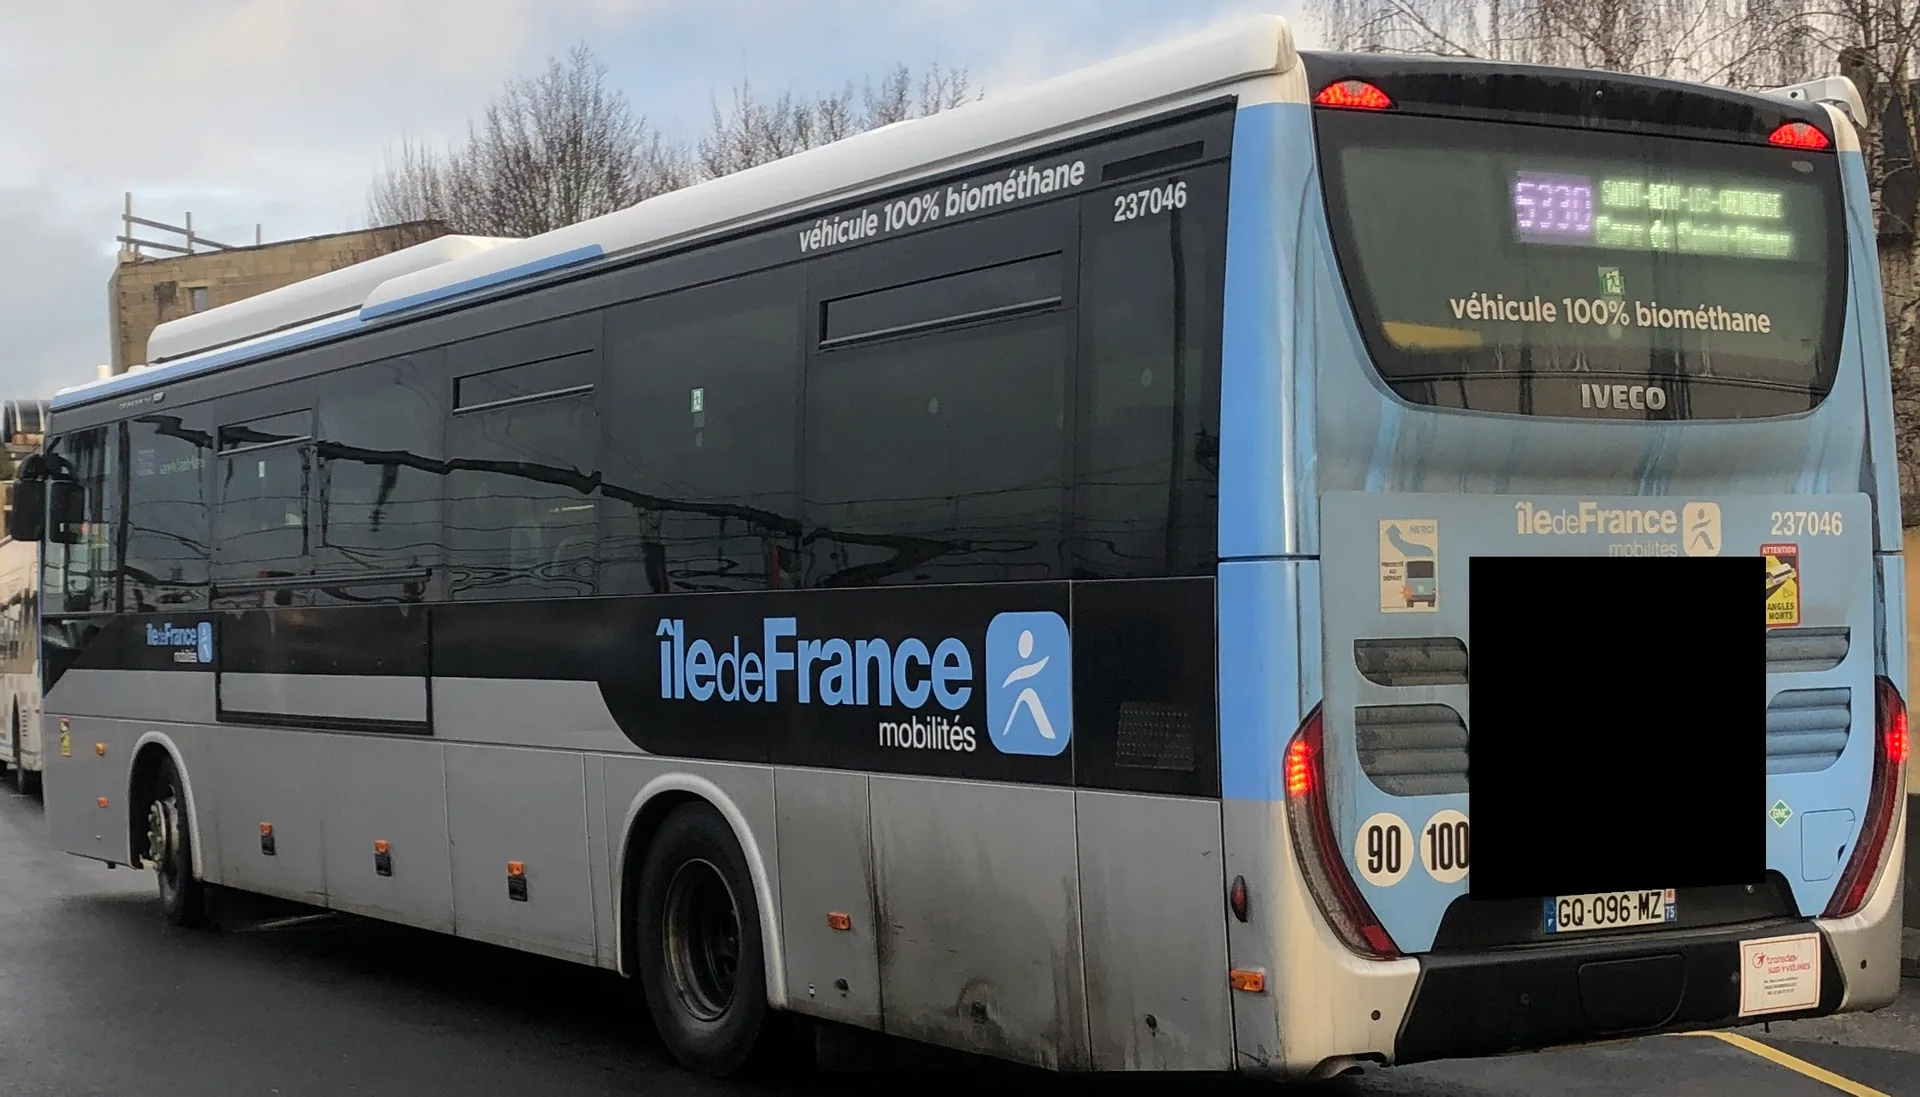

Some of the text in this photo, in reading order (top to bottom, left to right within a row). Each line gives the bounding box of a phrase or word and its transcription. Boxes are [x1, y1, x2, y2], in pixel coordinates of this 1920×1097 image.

[800, 160, 1085, 252] véhicule 100% biométhane
[1114, 181, 1187, 222] 237046
[1450, 292, 1771, 334] véhicule 100% biométhane
[1580, 383, 1666, 411] IVECO
[1770, 511, 1843, 536] 237046
[1762, 546, 1797, 555] ATTENTION
[1767, 602, 1795, 611] ANGLES
[1768, 611, 1794, 620] MORTS
[879, 715, 976, 753] mobilités
[1773, 808, 1788, 819] GNC
[1368, 825, 1401, 873] 90
[1426, 821, 1469, 870] 100
[1547, 891, 1675, 927] F GQ-096-MZ 75
[1768, 962, 1811, 975] SUD YVELINES
